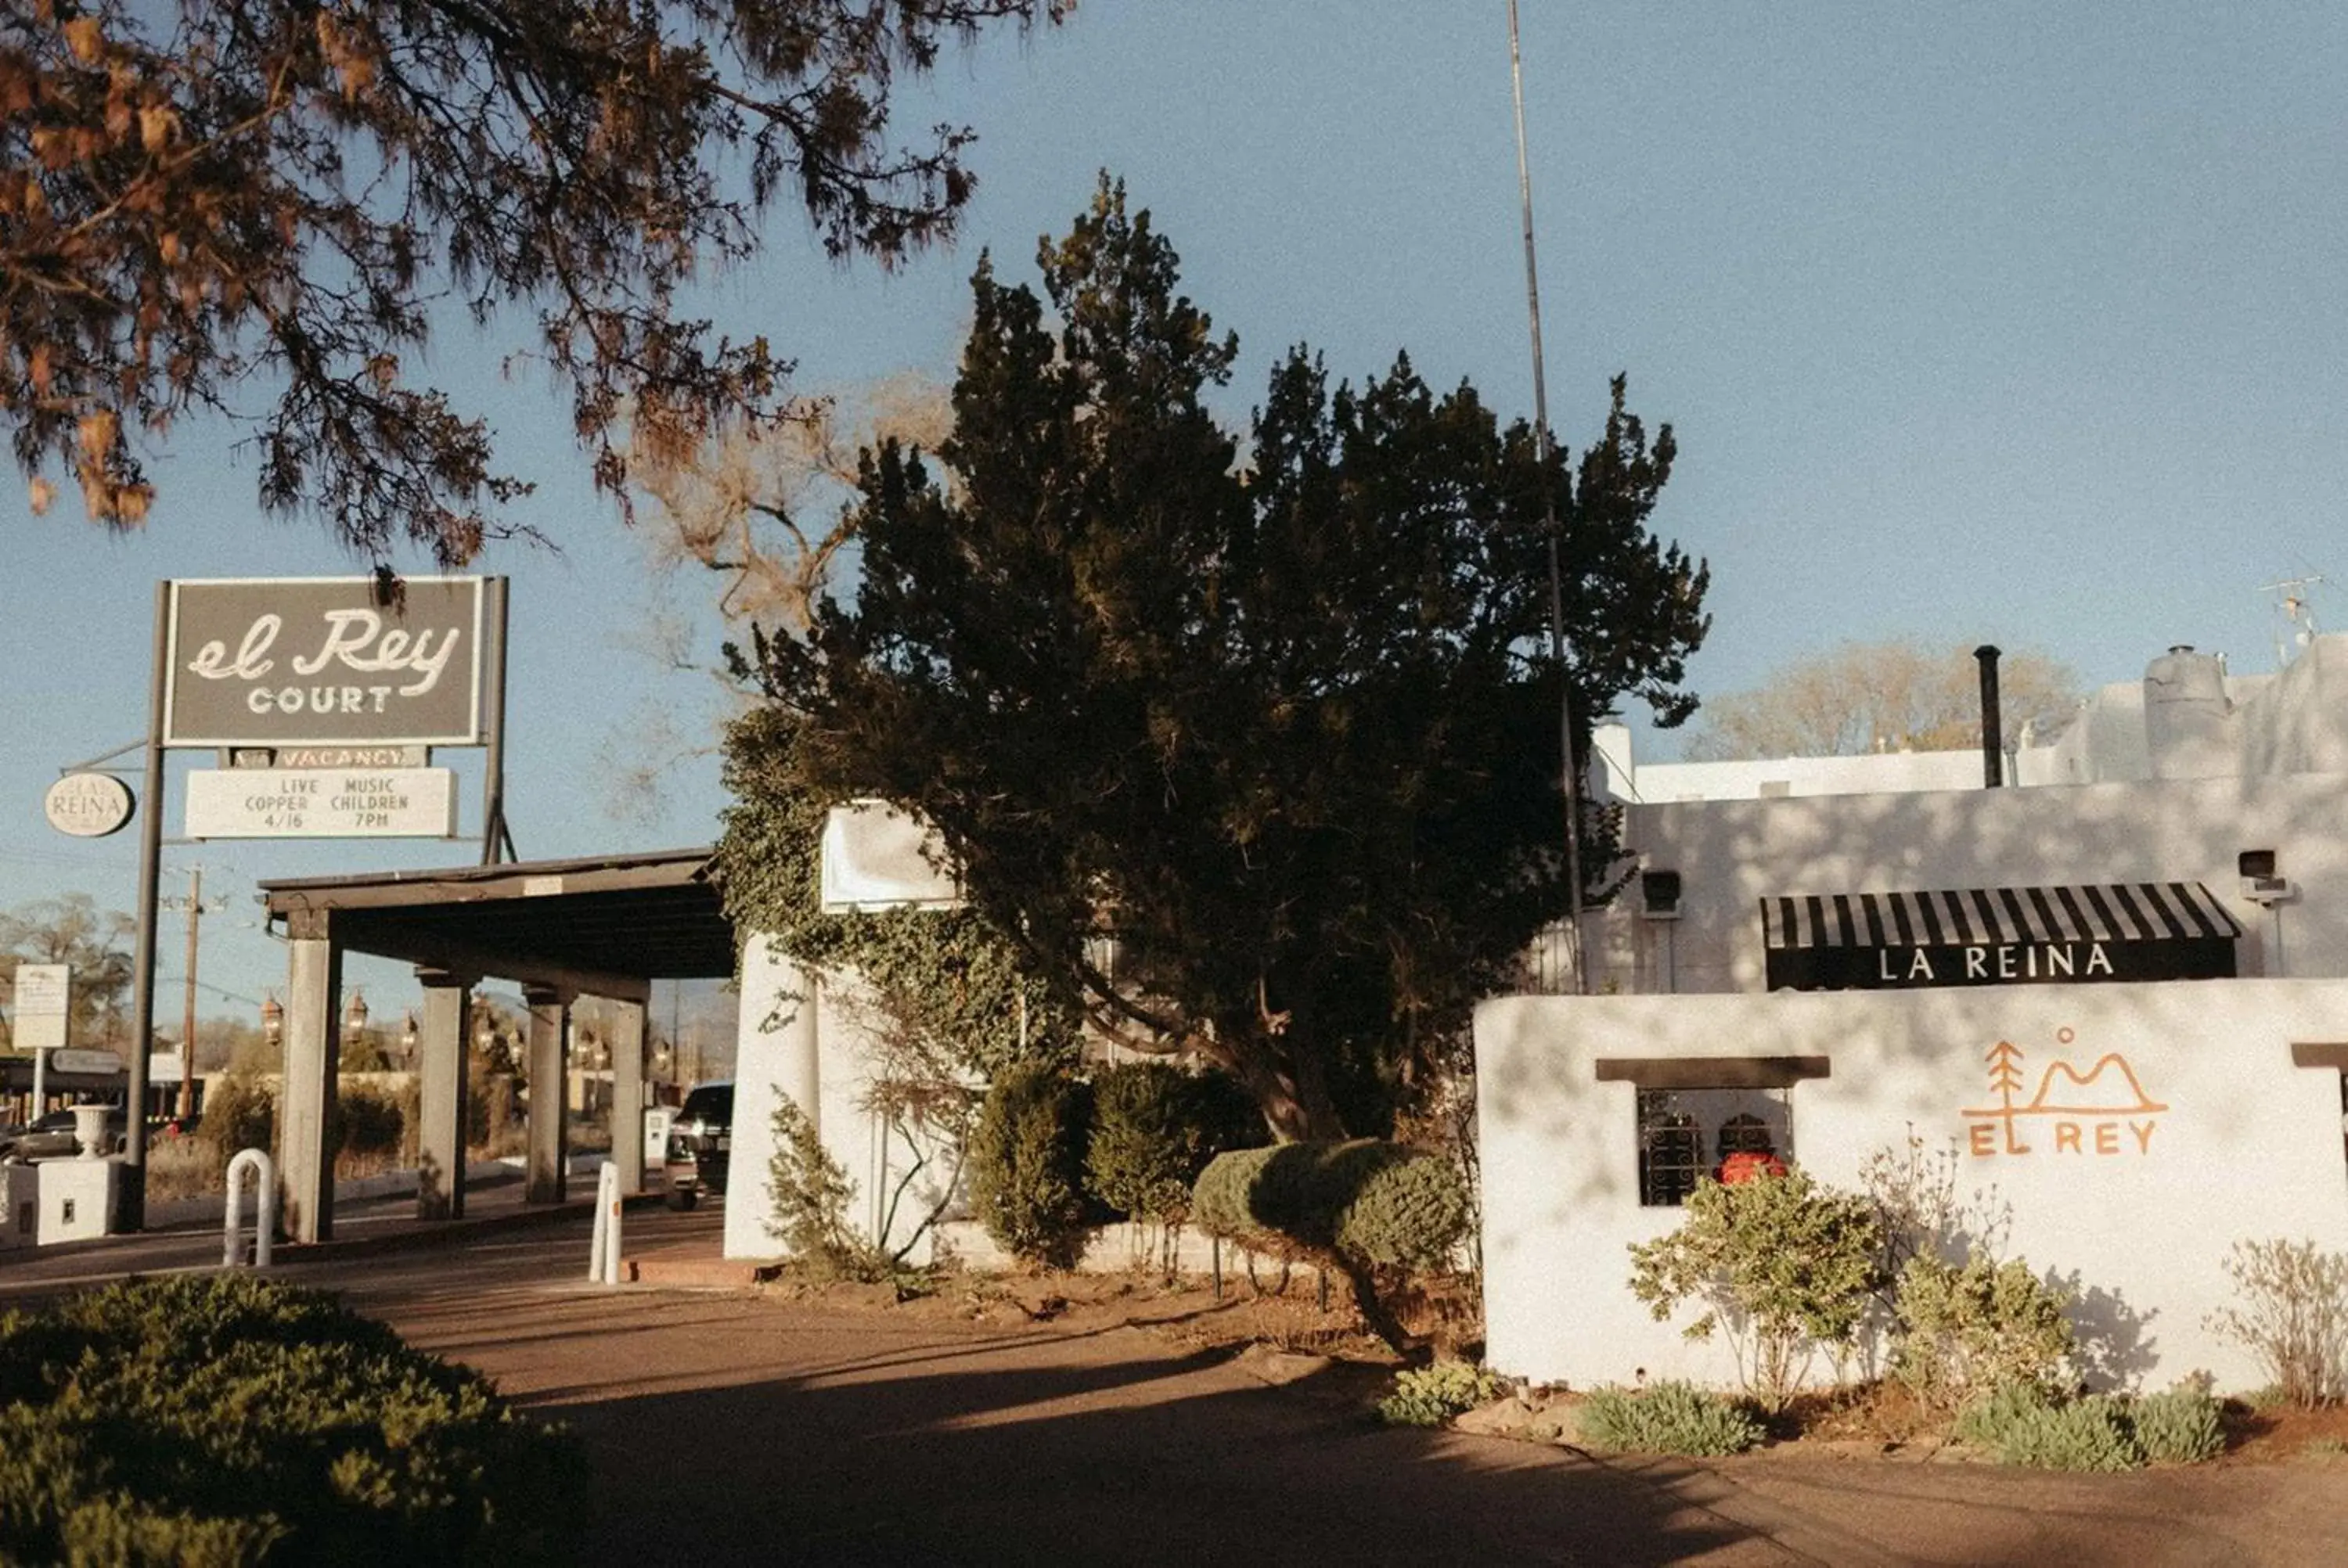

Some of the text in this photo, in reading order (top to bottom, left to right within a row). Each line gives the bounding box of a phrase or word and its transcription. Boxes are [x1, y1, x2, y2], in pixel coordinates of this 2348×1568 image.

[187, 608, 460, 696] el Rey
[247, 686, 392, 714] COURT
[283, 750, 405, 767] VACANCY
[281, 778, 394, 794] LIVE MUSIC
[52, 796, 121, 815] REINA
[244, 796, 409, 811] COPPER CHILDREN
[264, 813, 389, 828] 4/16 7PM
[1880, 943, 2114, 980] LA REINA
[1969, 1120, 2155, 1156] EL REY
